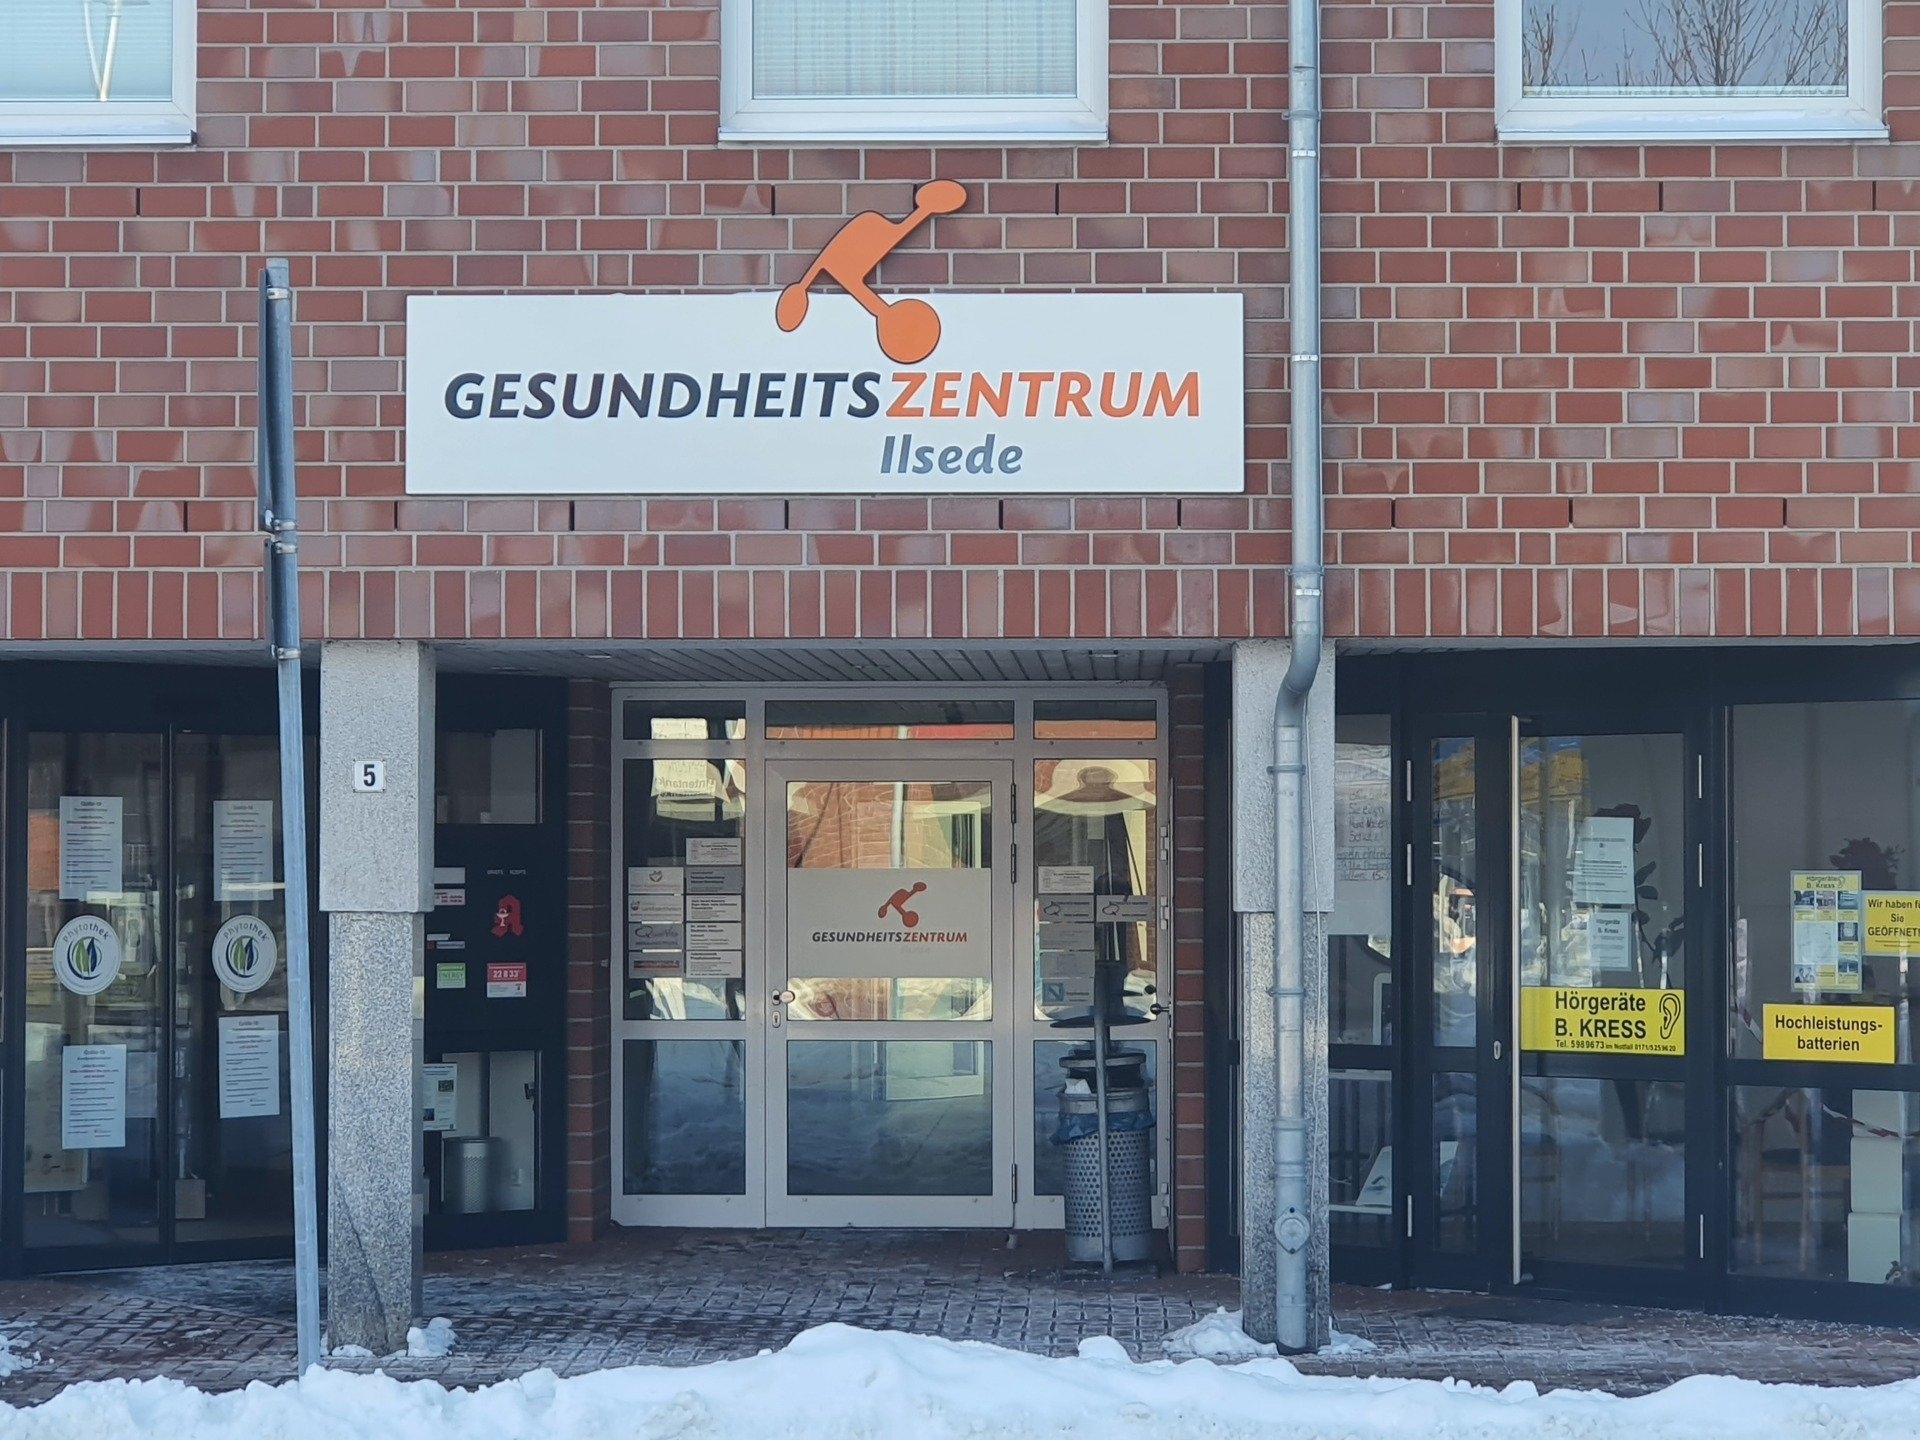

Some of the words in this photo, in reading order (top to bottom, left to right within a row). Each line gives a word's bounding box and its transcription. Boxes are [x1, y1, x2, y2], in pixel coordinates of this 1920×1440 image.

[444, 371, 1200, 419] GESUNDHEITSZENTRUM
[880, 434, 1023, 475] Ilsede
[363, 764, 376, 787] 5
[1867, 899, 1883, 909] Wir
[1885, 899, 1912, 909] haben
[1890, 913, 1905, 923] Sie
[812, 931, 968, 943] GESUNDHEITSZENTRUM
[1555, 991, 1646, 1015] Hörgeräte
[1555, 1018, 1573, 1037] B.
[1579, 1018, 1646, 1039] KRESS
[1775, 1014, 1883, 1035] Hochleistungs-
[1555, 1039, 1569, 1048] Tel.
[1797, 1036, 1860, 1051] batterien
